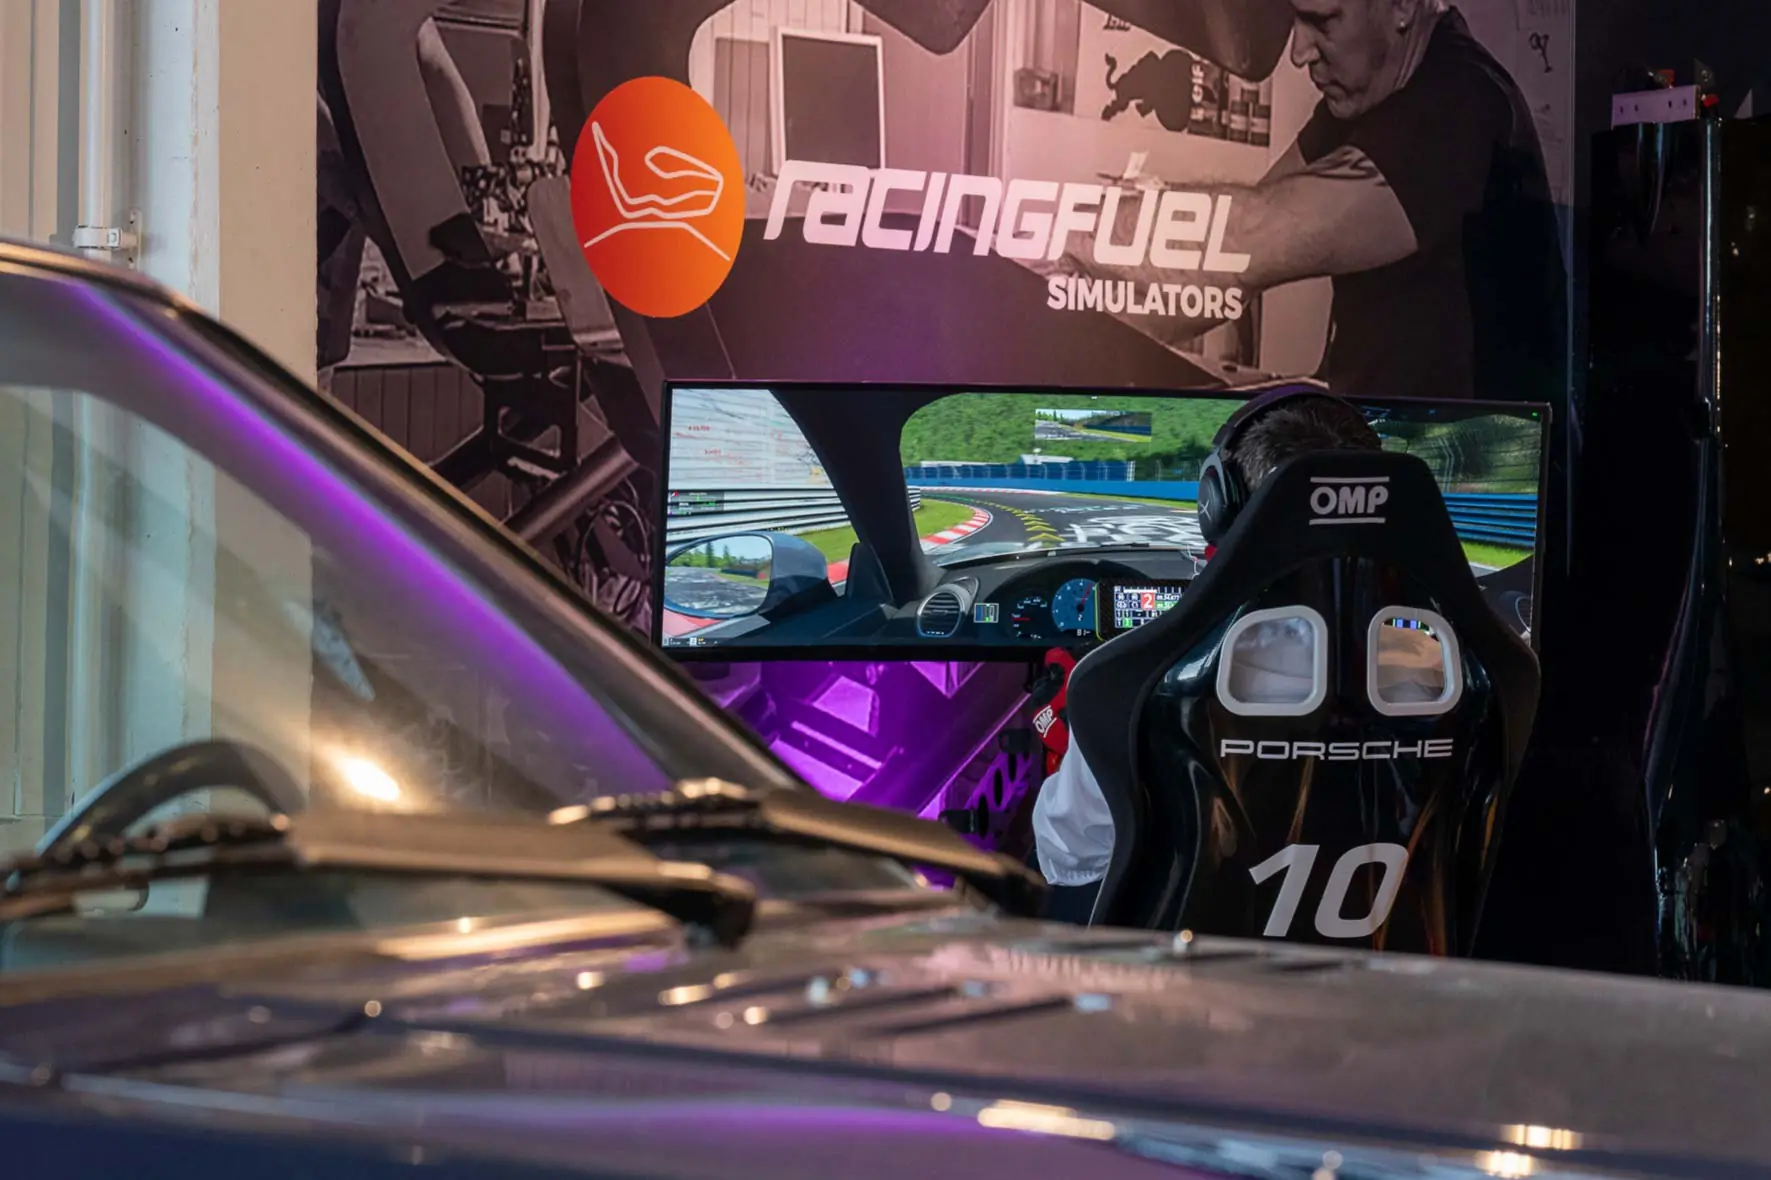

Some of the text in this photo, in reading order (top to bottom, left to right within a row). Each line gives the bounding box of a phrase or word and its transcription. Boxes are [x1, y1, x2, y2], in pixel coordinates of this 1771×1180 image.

[1046, 278, 1243, 320] SIMULATORS
[1310, 485, 1389, 515] OMP
[1143, 593, 1153, 609] 2
[1035, 708, 1054, 734] OMP
[1220, 739, 1454, 761] PORSCHE
[1248, 842, 1410, 938] 10
